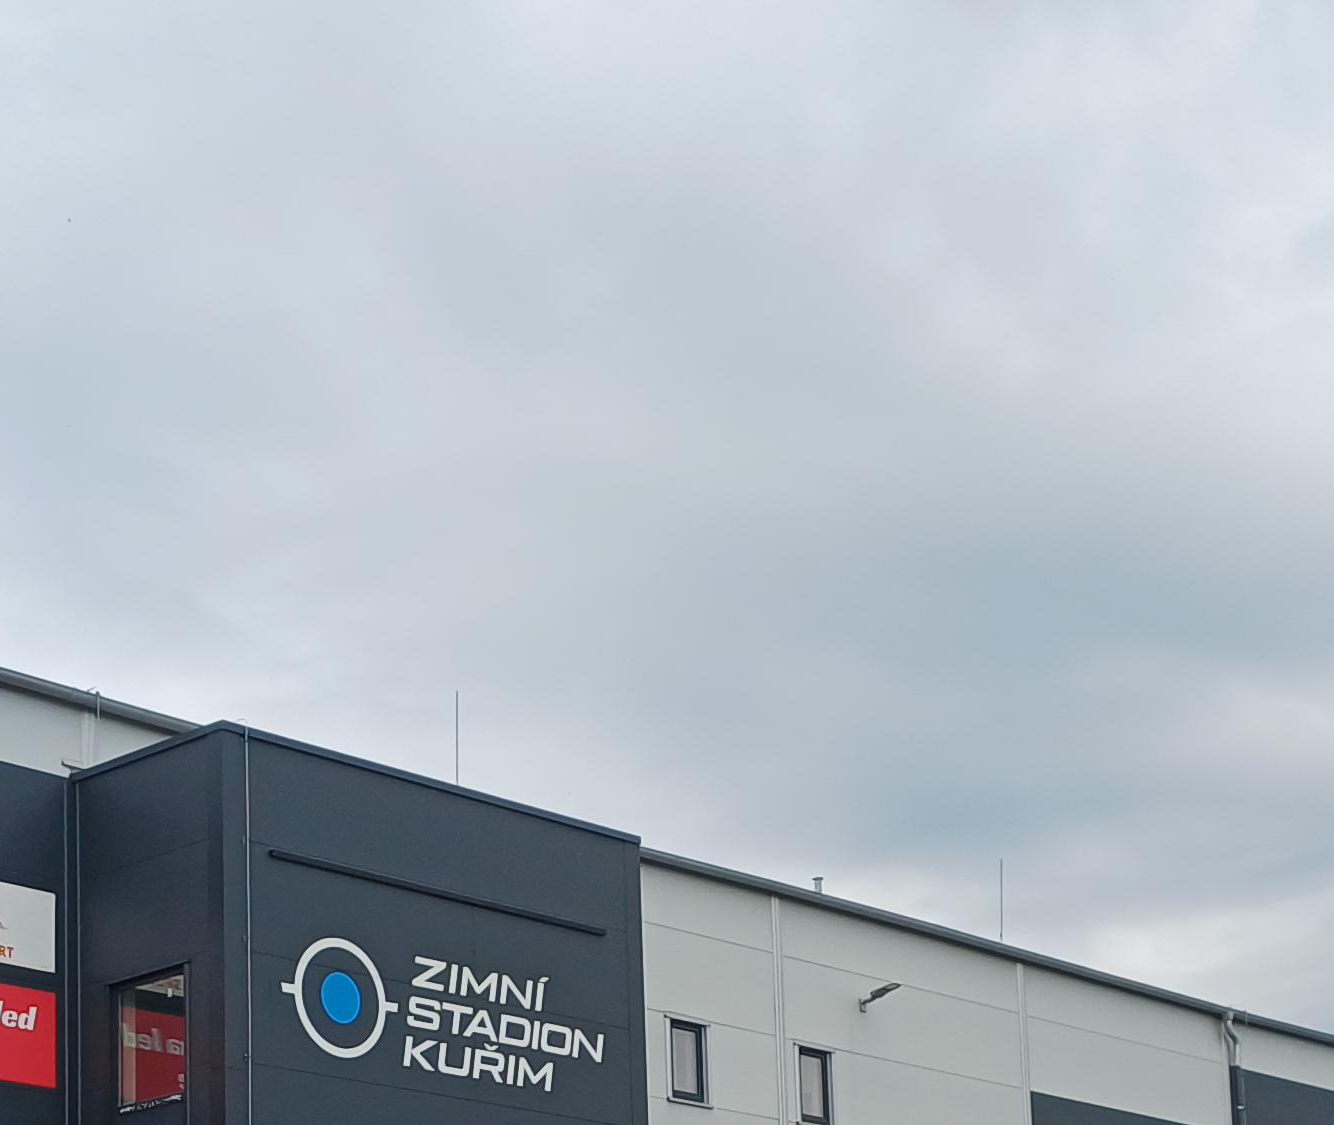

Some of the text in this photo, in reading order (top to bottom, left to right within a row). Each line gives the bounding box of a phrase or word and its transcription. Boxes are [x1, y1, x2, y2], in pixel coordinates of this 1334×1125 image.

[411, 955, 549, 1013] ZIMNÍ
[406, 996, 604, 1063] STADION
[402, 1035, 555, 1092] KUŘIM
